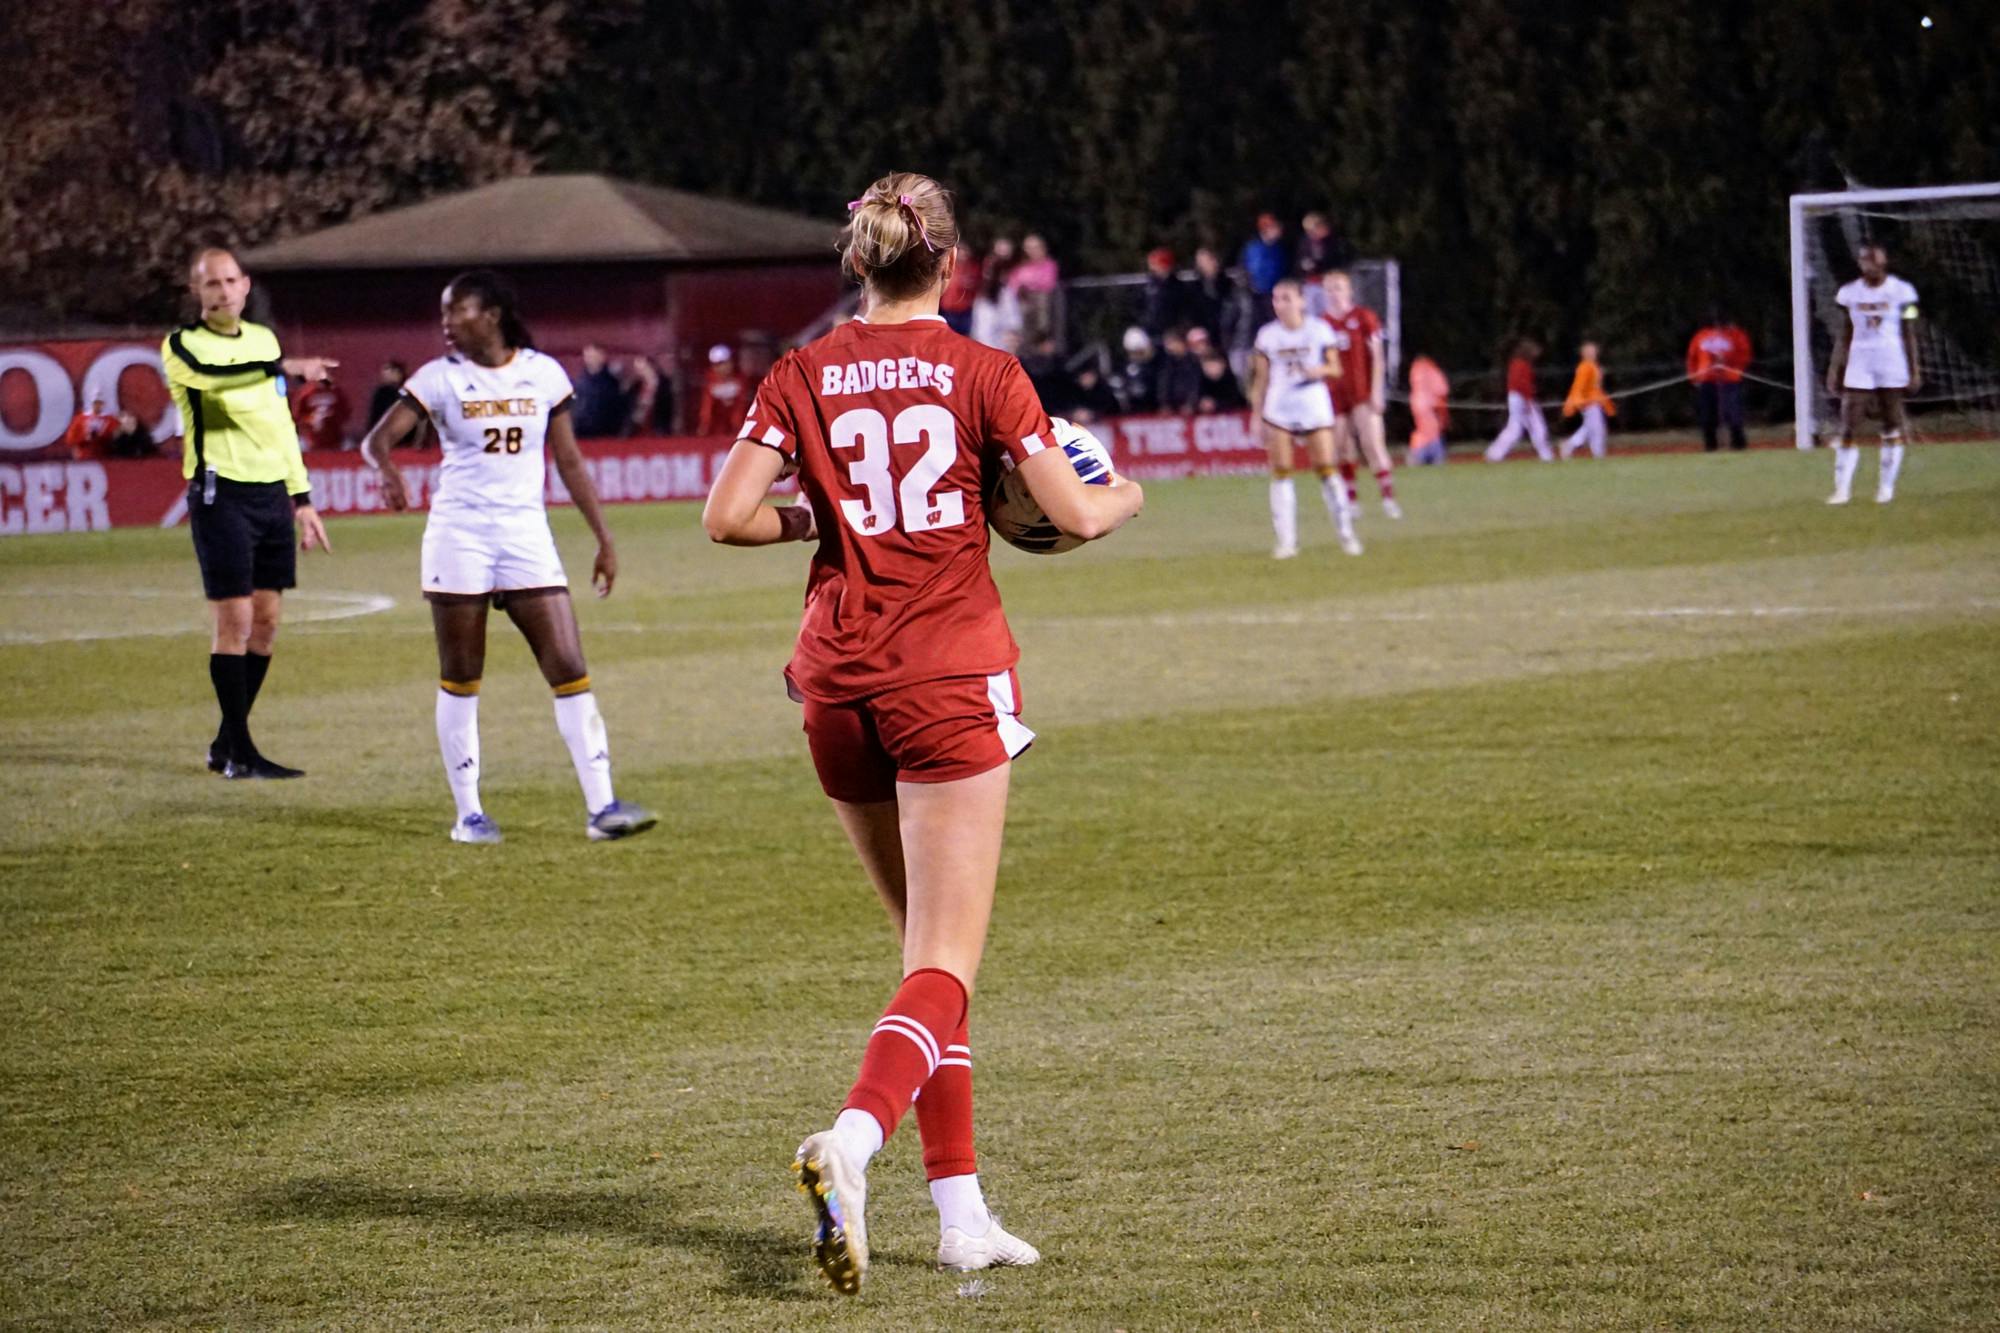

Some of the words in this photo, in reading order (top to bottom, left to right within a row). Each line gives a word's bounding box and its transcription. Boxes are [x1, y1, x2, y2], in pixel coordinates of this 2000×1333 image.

[821, 357, 954, 396] BADGERS
[483, 427, 523, 454] 28
[830, 404, 965, 536] 32
